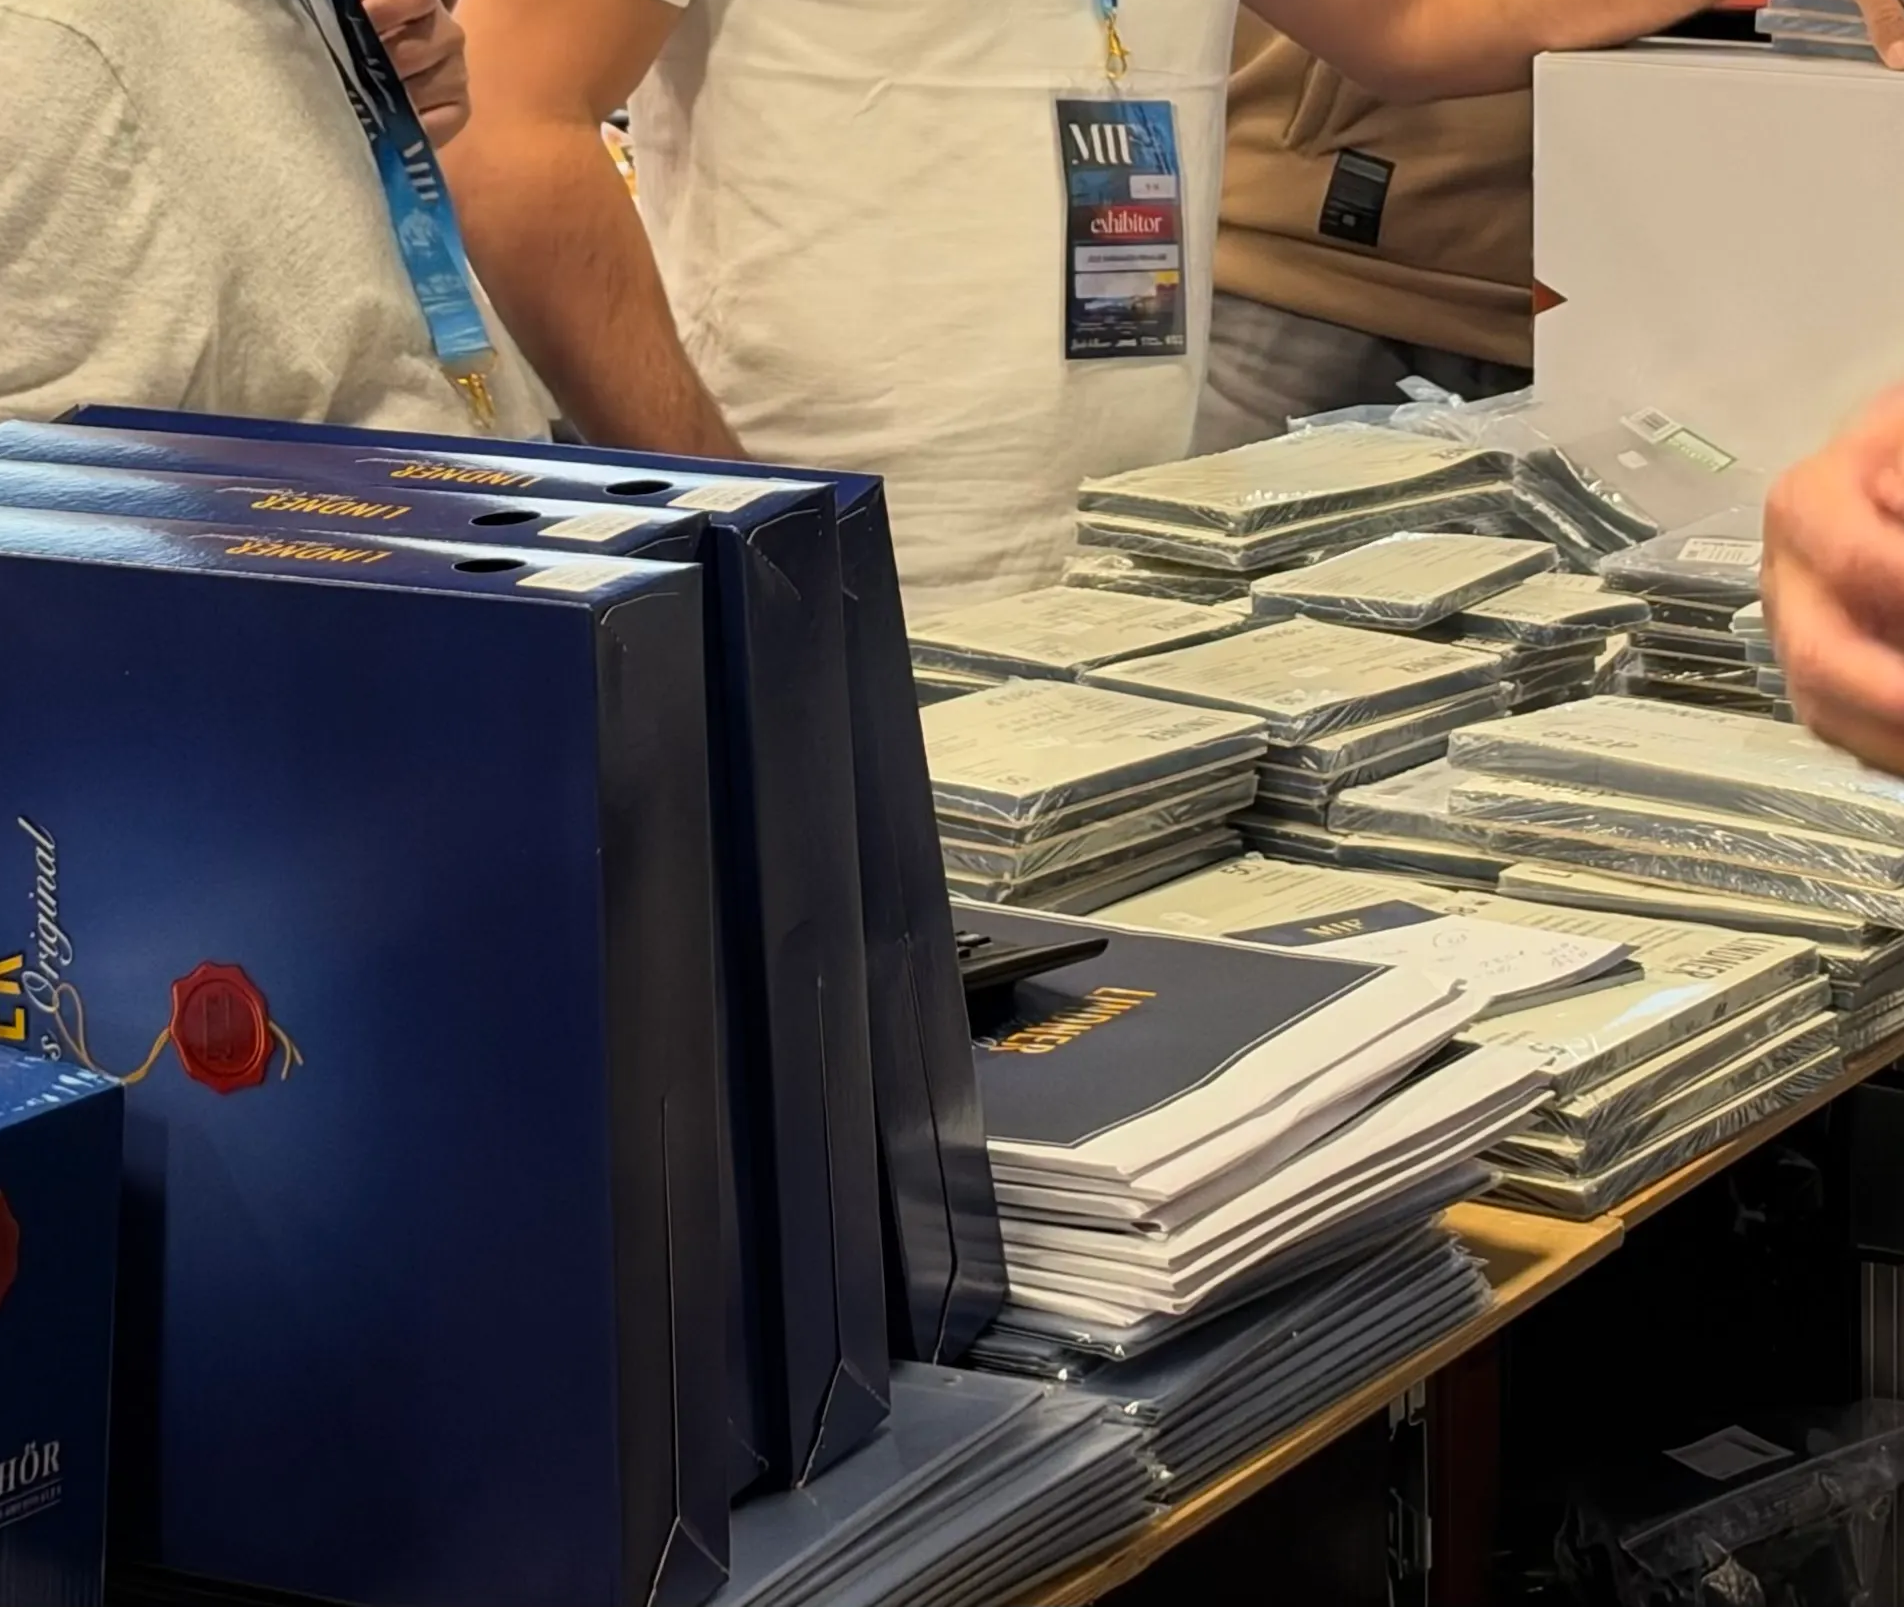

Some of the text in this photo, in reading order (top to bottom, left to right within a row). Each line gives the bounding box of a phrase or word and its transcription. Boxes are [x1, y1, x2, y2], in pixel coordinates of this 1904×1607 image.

[1091, 210, 1162, 234] exhibitor
[389, 462, 545, 490] LINDNER
[251, 492, 411, 521] LINDNER
[224, 539, 393, 565] LINDNER
[17, 816, 73, 1012] Original
[1666, 937, 1785, 979] LINDNER
[989, 987, 1157, 1054] LINDNER
